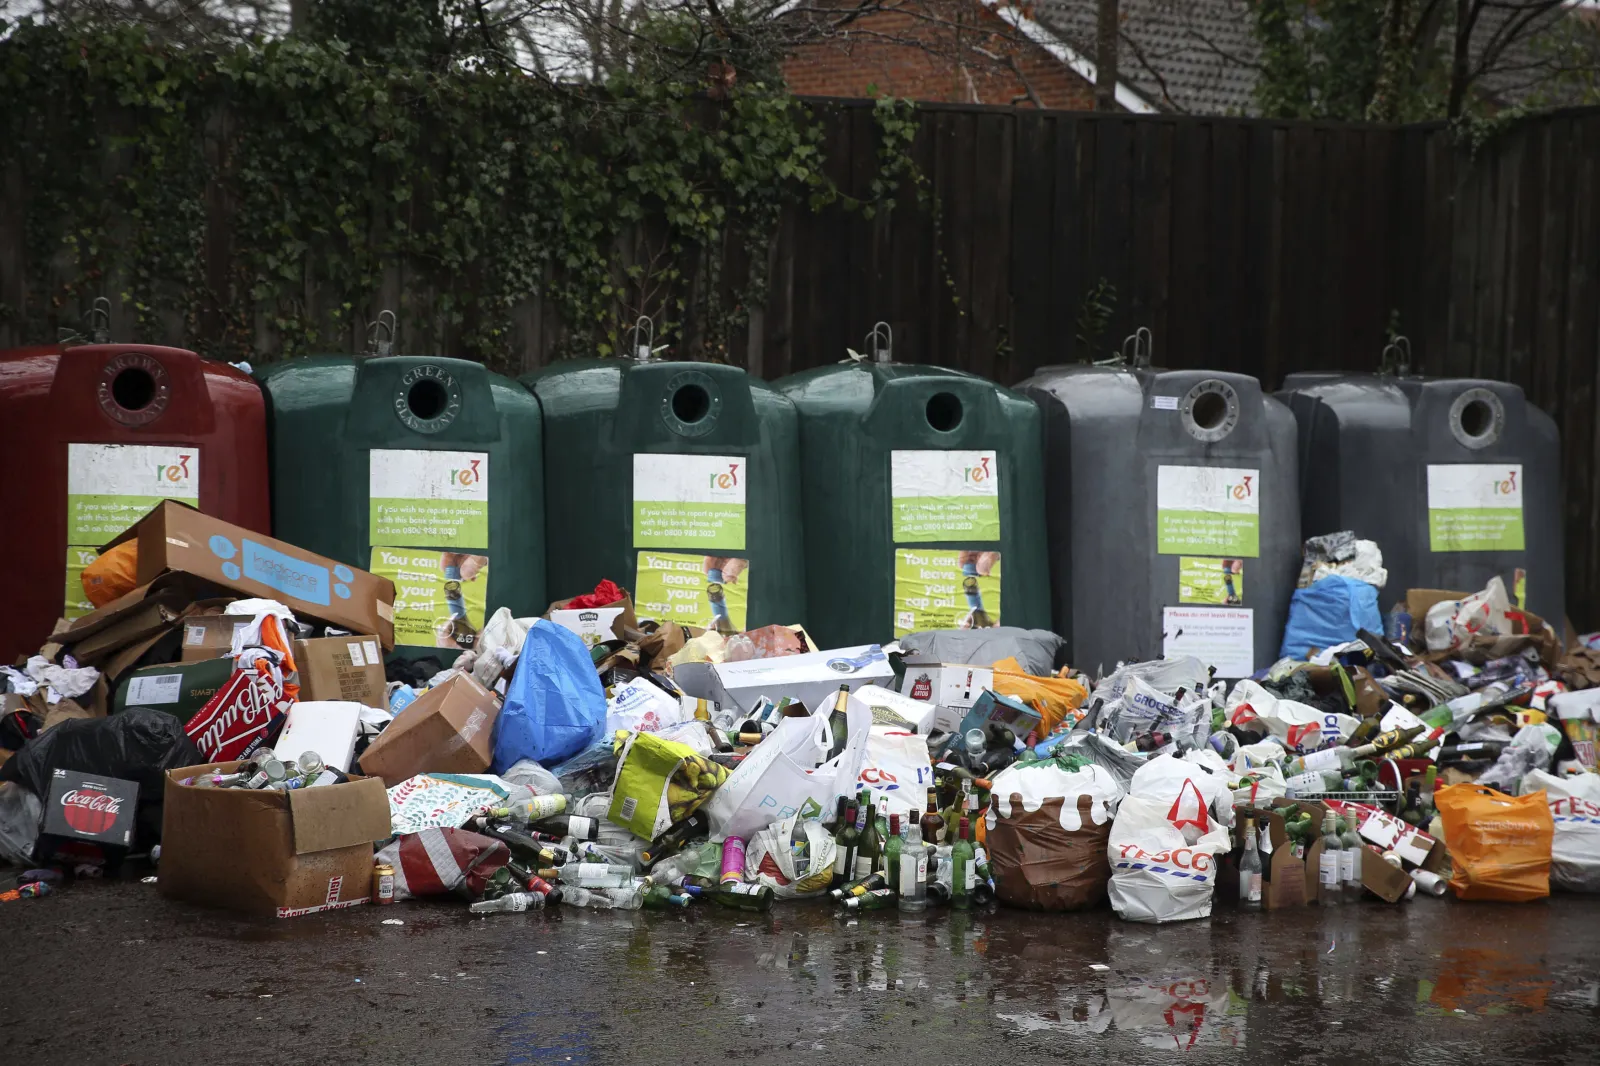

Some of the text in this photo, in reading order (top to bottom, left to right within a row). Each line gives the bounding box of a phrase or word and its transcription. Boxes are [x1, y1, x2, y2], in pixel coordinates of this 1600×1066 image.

[402, 366, 455, 387] GREEN
[157, 454, 191, 482] re3
[451, 459, 481, 486] re3
[964, 457, 990, 483] re3
[710, 463, 739, 490] re3
[1494, 471, 1517, 495] re3
[1226, 475, 1253, 501] re3
[84, 504, 99, 512] you
[101, 503, 121, 511] wish
[384, 506, 398, 514] you
[399, 505, 416, 513] wish
[455, 507, 482, 516] problem
[647, 509, 660, 517] you
[661, 508, 677, 517] wish
[687, 510, 707, 518] report
[76, 513, 92, 521] with
[377, 515, 393, 523] with
[395, 515, 407, 524] this
[452, 517, 464, 525] call
[640, 518, 656, 526] with
[711, 519, 723, 528] call
[664, 529, 682, 537] 0800
[380, 551, 438, 568] You can
[645, 555, 700, 572] You can
[904, 553, 956, 566] You can
[396, 568, 437, 583] leave
[662, 572, 701, 586] leave
[920, 568, 956, 580] leave
[400, 585, 436, 599] your
[666, 588, 701, 602] your
[924, 584, 956, 596] your
[410, 600, 435, 612] on!
[645, 601, 699, 615] cap on!
[905, 596, 955, 610] cap on!
[915, 683, 930, 691] STELLA
[54, 768, 66, 776] 24
[60, 789, 125, 815] Coca-Cola
[1548, 796, 1600, 817] TES
[1474, 819, 1541, 832] Sainsbury's
[1119, 844, 1213, 872] TESCO
